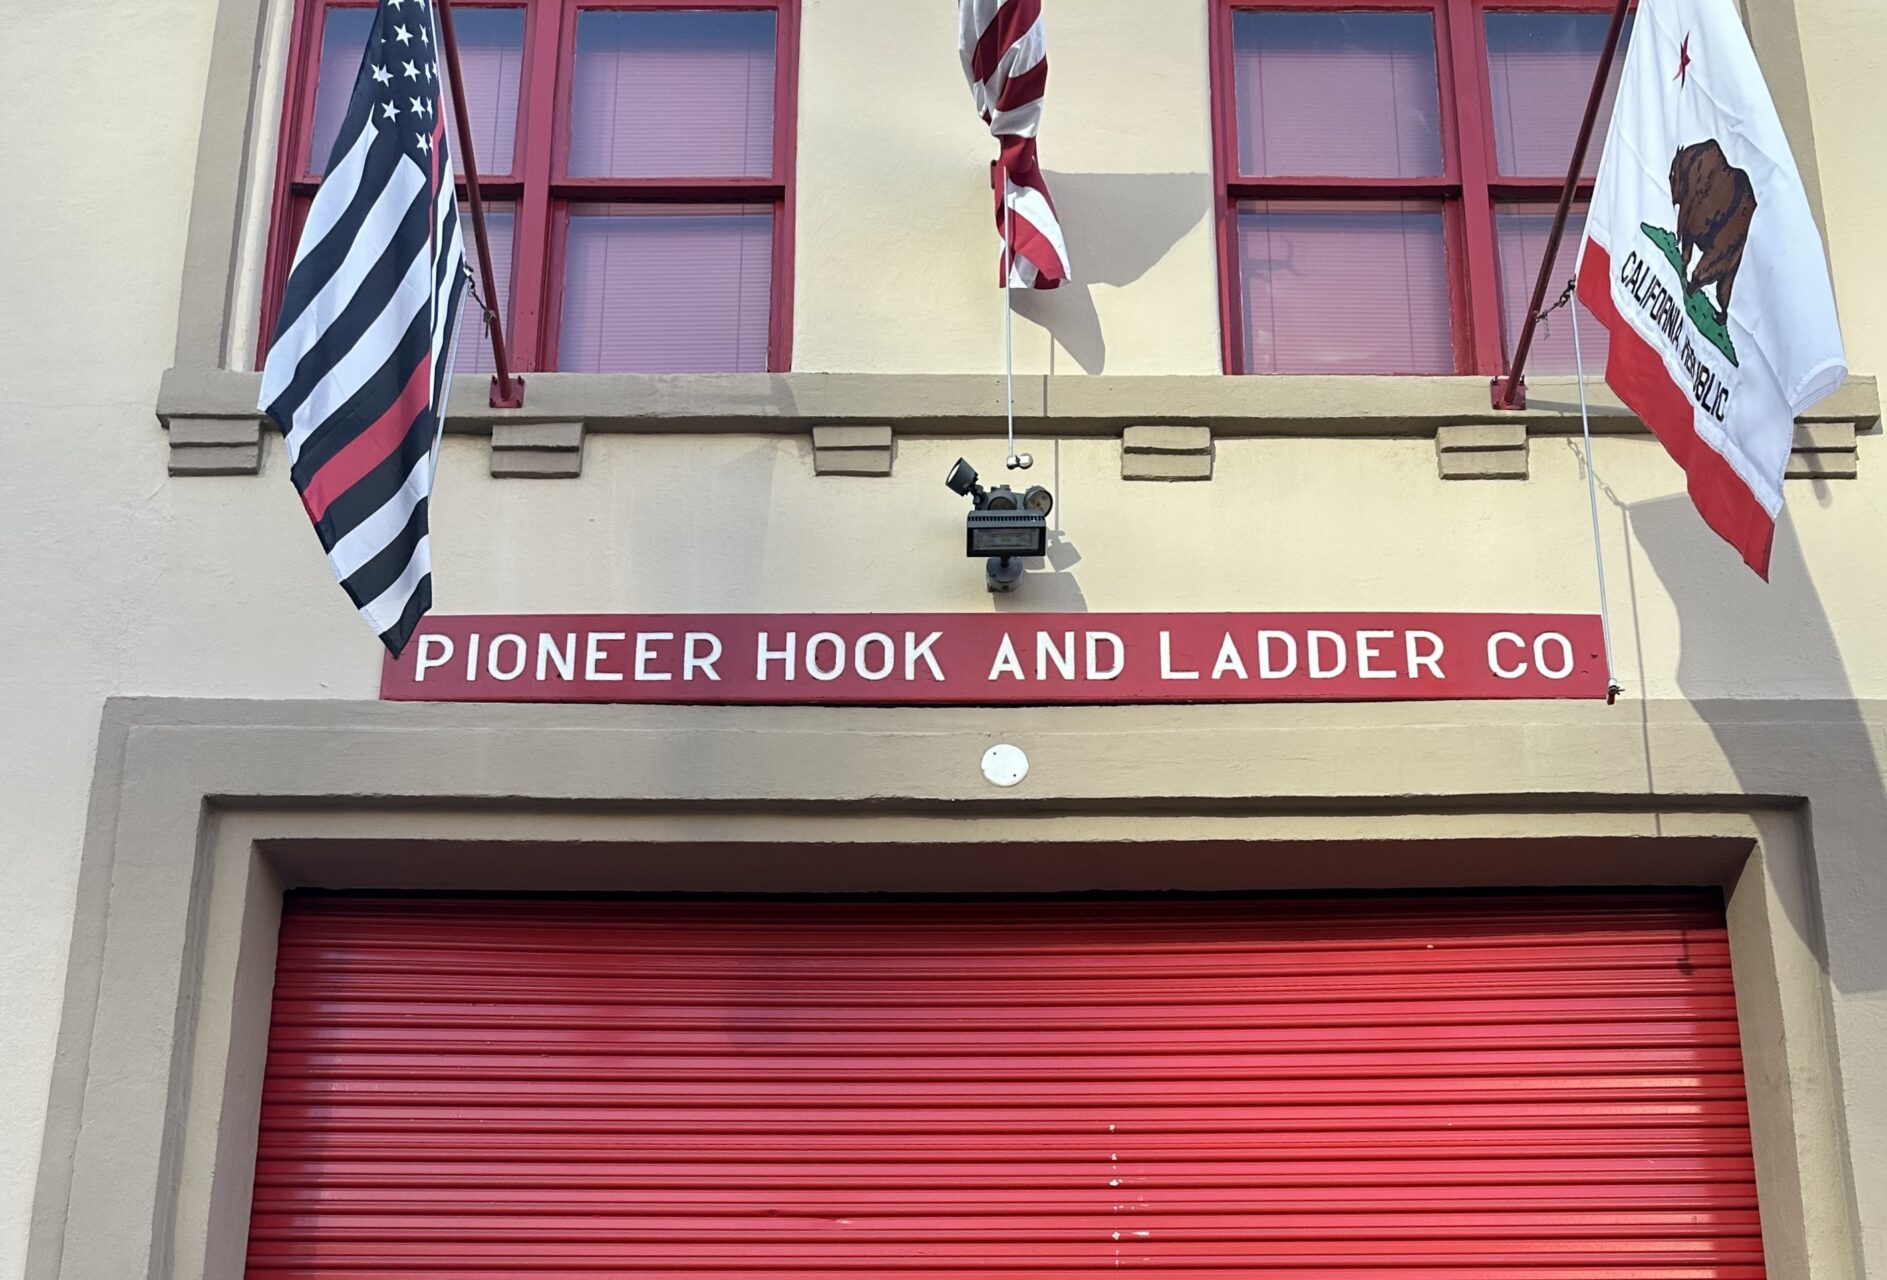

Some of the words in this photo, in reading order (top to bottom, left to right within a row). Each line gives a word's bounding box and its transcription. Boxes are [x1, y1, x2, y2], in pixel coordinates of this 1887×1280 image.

[1621, 251, 1684, 351] CALIFORNIA
[414, 632, 722, 682] PIONEER
[756, 631, 945, 682] HOOK
[988, 631, 1124, 681] AND
[1160, 630, 1446, 680] LADDER
[1487, 631, 1574, 680] CO
